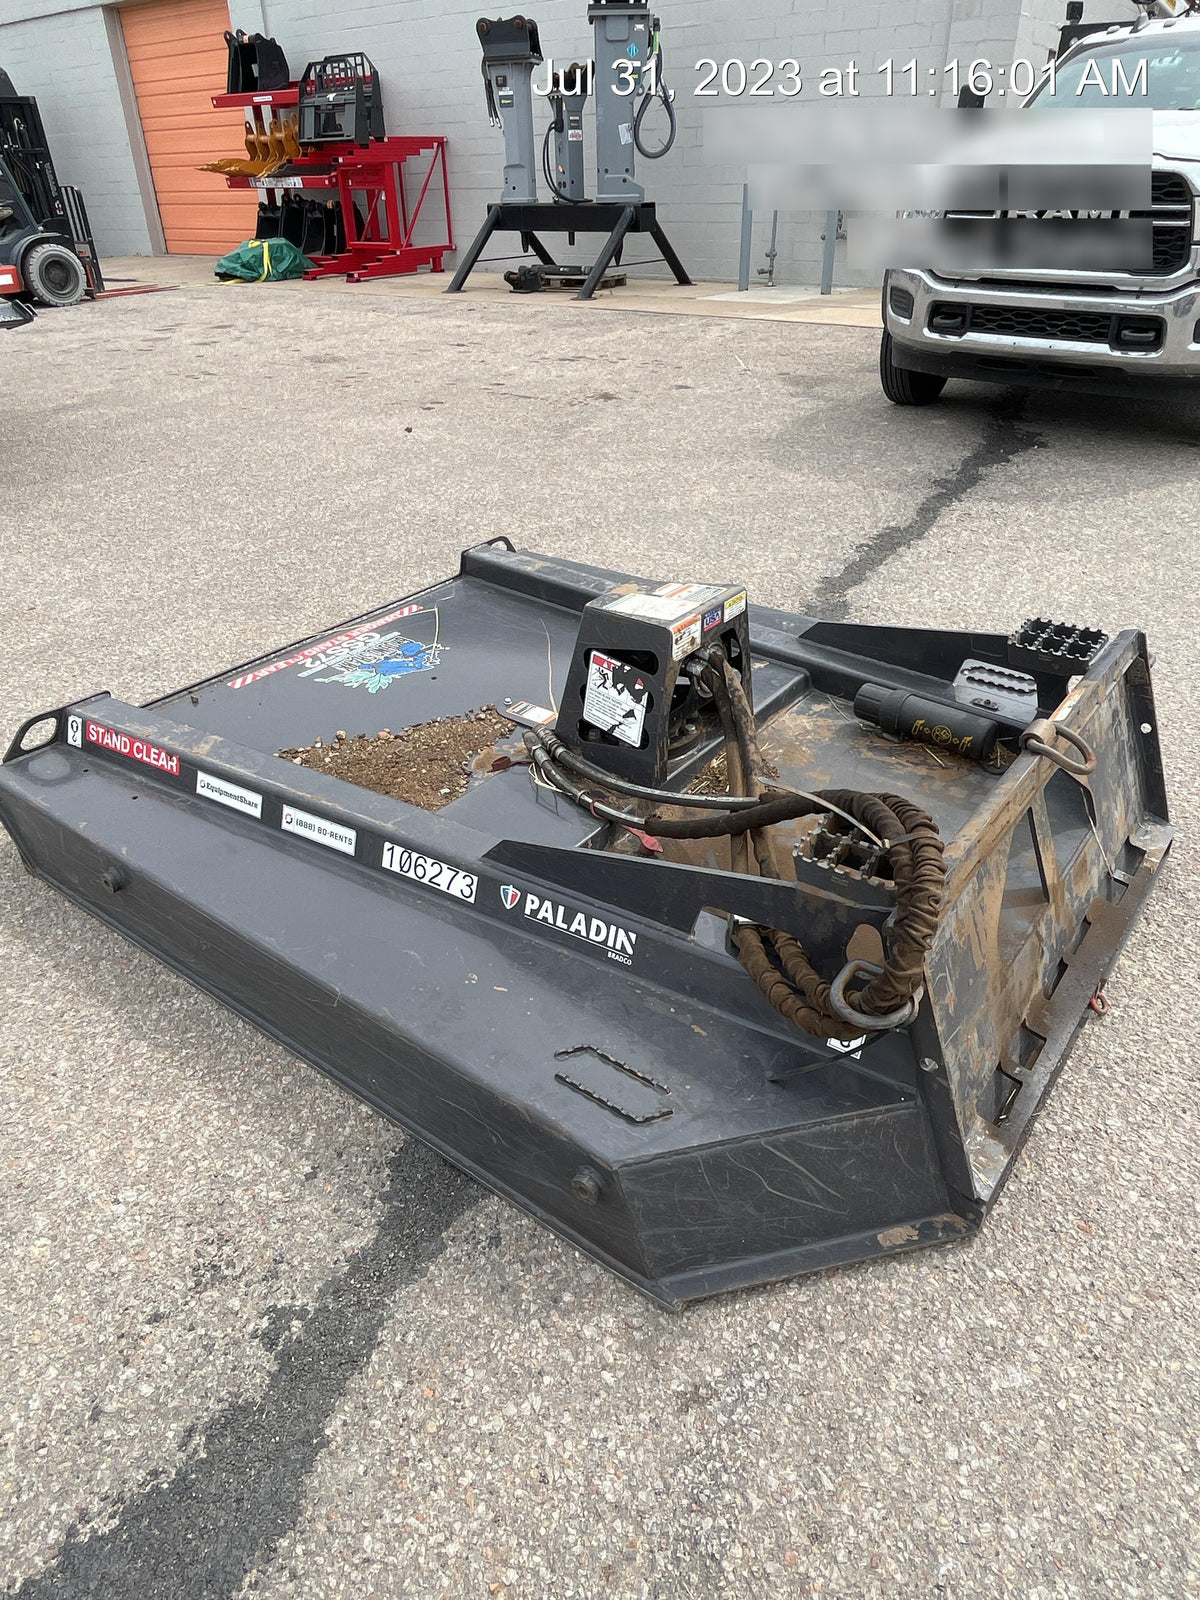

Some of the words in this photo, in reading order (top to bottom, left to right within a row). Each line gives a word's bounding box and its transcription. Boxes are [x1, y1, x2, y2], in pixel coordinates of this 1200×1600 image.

[705, 611, 720, 626] USA
[298, 631, 347, 658] STAND
[298, 632, 382, 669] GSS72
[89, 724, 130, 754] STAND
[133, 742, 178, 773] CLEAR
[206, 781, 259, 809] EquipmentShare
[295, 815, 316, 833] (888)
[386, 845, 475, 899] 106273
[524, 893, 637, 956] PALADIN
[607, 951, 633, 966] BRADCO
